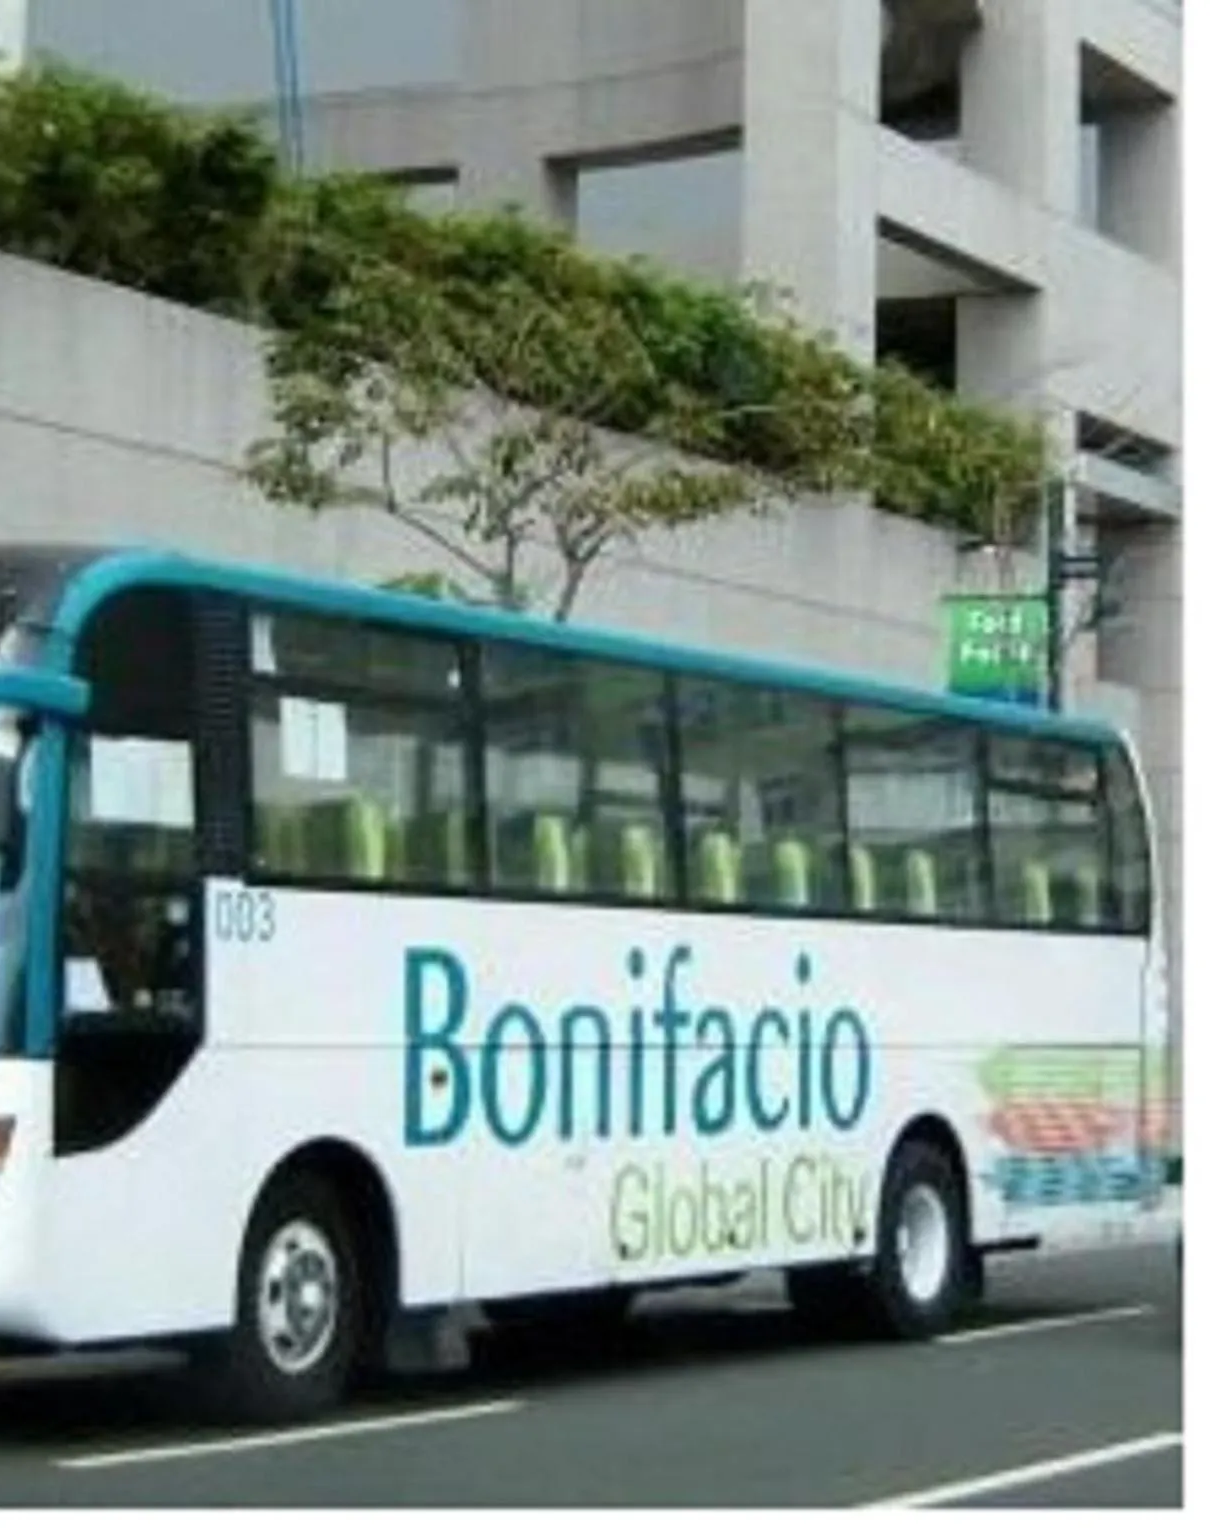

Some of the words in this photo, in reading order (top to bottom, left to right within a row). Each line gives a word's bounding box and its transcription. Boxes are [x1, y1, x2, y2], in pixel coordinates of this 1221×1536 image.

[215, 890, 277, 942] 003
[403, 945, 872, 1149] Bonifacio
[610, 1160, 771, 1262] Global
[783, 1151, 875, 1249] City
